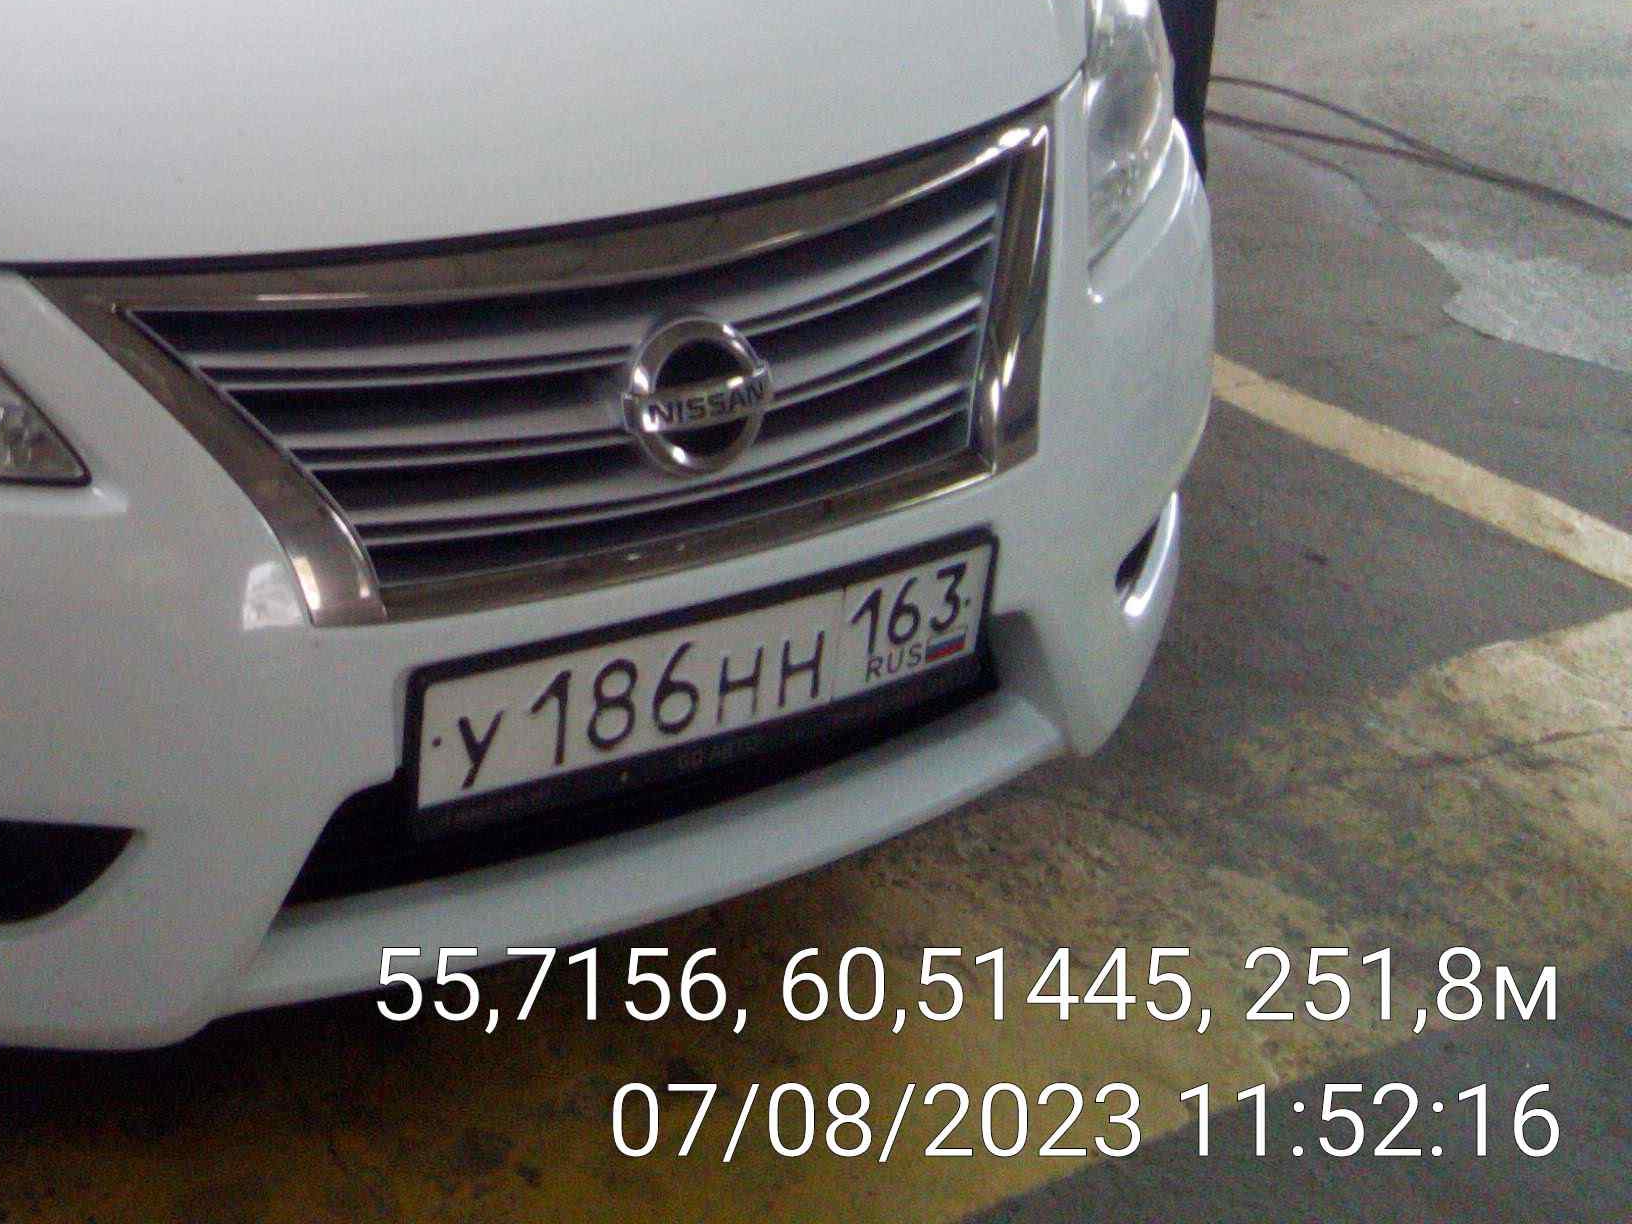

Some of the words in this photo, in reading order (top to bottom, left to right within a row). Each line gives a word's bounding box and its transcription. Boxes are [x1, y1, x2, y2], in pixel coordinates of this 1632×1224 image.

[645, 380, 766, 427] NISSAN
[850, 561, 968, 656] 163
[864, 642, 923, 683] RUS
